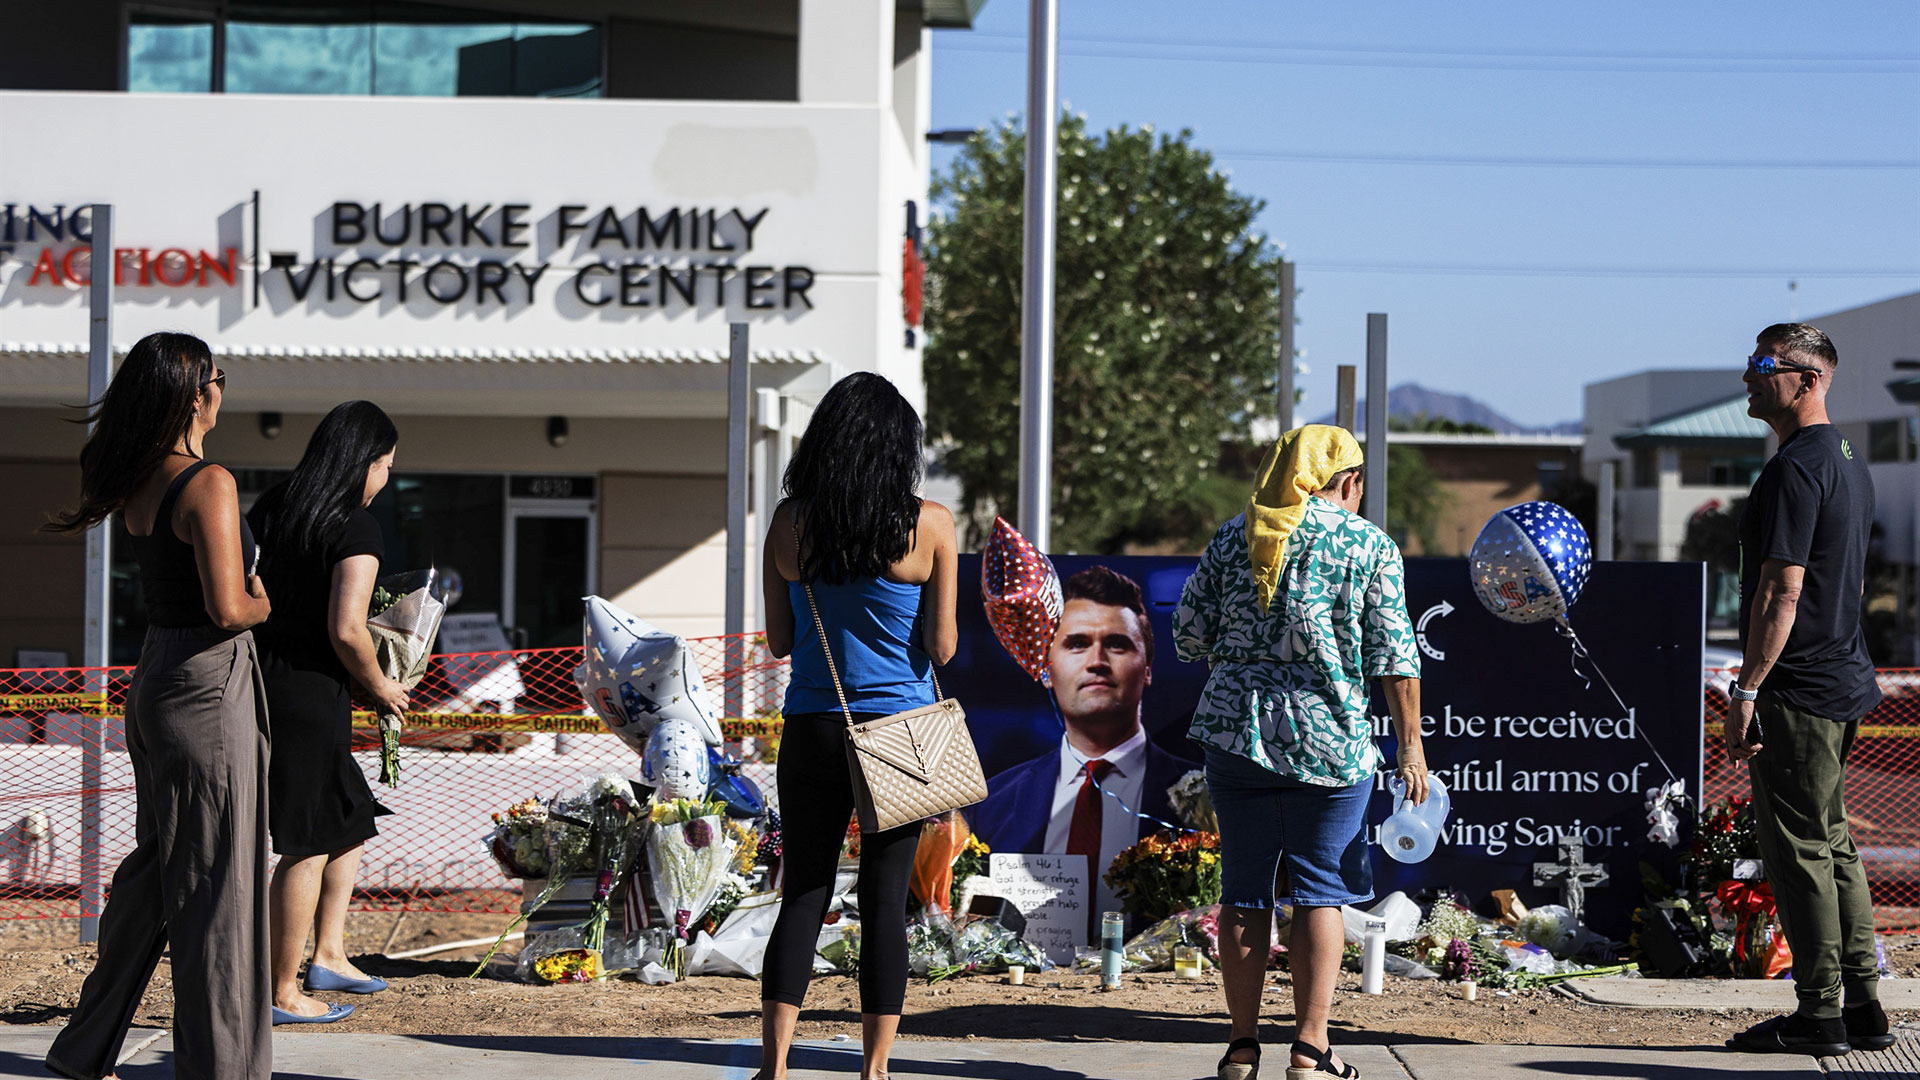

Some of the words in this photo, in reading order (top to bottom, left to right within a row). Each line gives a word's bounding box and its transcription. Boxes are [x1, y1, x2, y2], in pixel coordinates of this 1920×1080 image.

[332, 202, 531, 248] BURKE
[558, 205, 770, 252] FAMILY
[26, 245, 237, 287] ACTION
[283, 257, 551, 305] VICTORY
[576, 265, 816, 310] CENTER
[1478, 576, 1555, 613] USA
[594, 681, 662, 728] SA
[534, 717, 599, 732] CAUTION
[1444, 704, 1486, 738] be
[1493, 707, 1636, 739] received
[1511, 770, 1601, 793] arms
[1607, 762, 1649, 793] of
[1514, 817, 1629, 848] Savior.
[995, 855, 1030, 870] Psalm
[995, 872, 1014, 884] God
[1019, 875, 1028, 883] is
[1032, 875, 1048, 883] our
[1051, 871, 1081, 888] refuge
[1059, 899, 1080, 911] help
